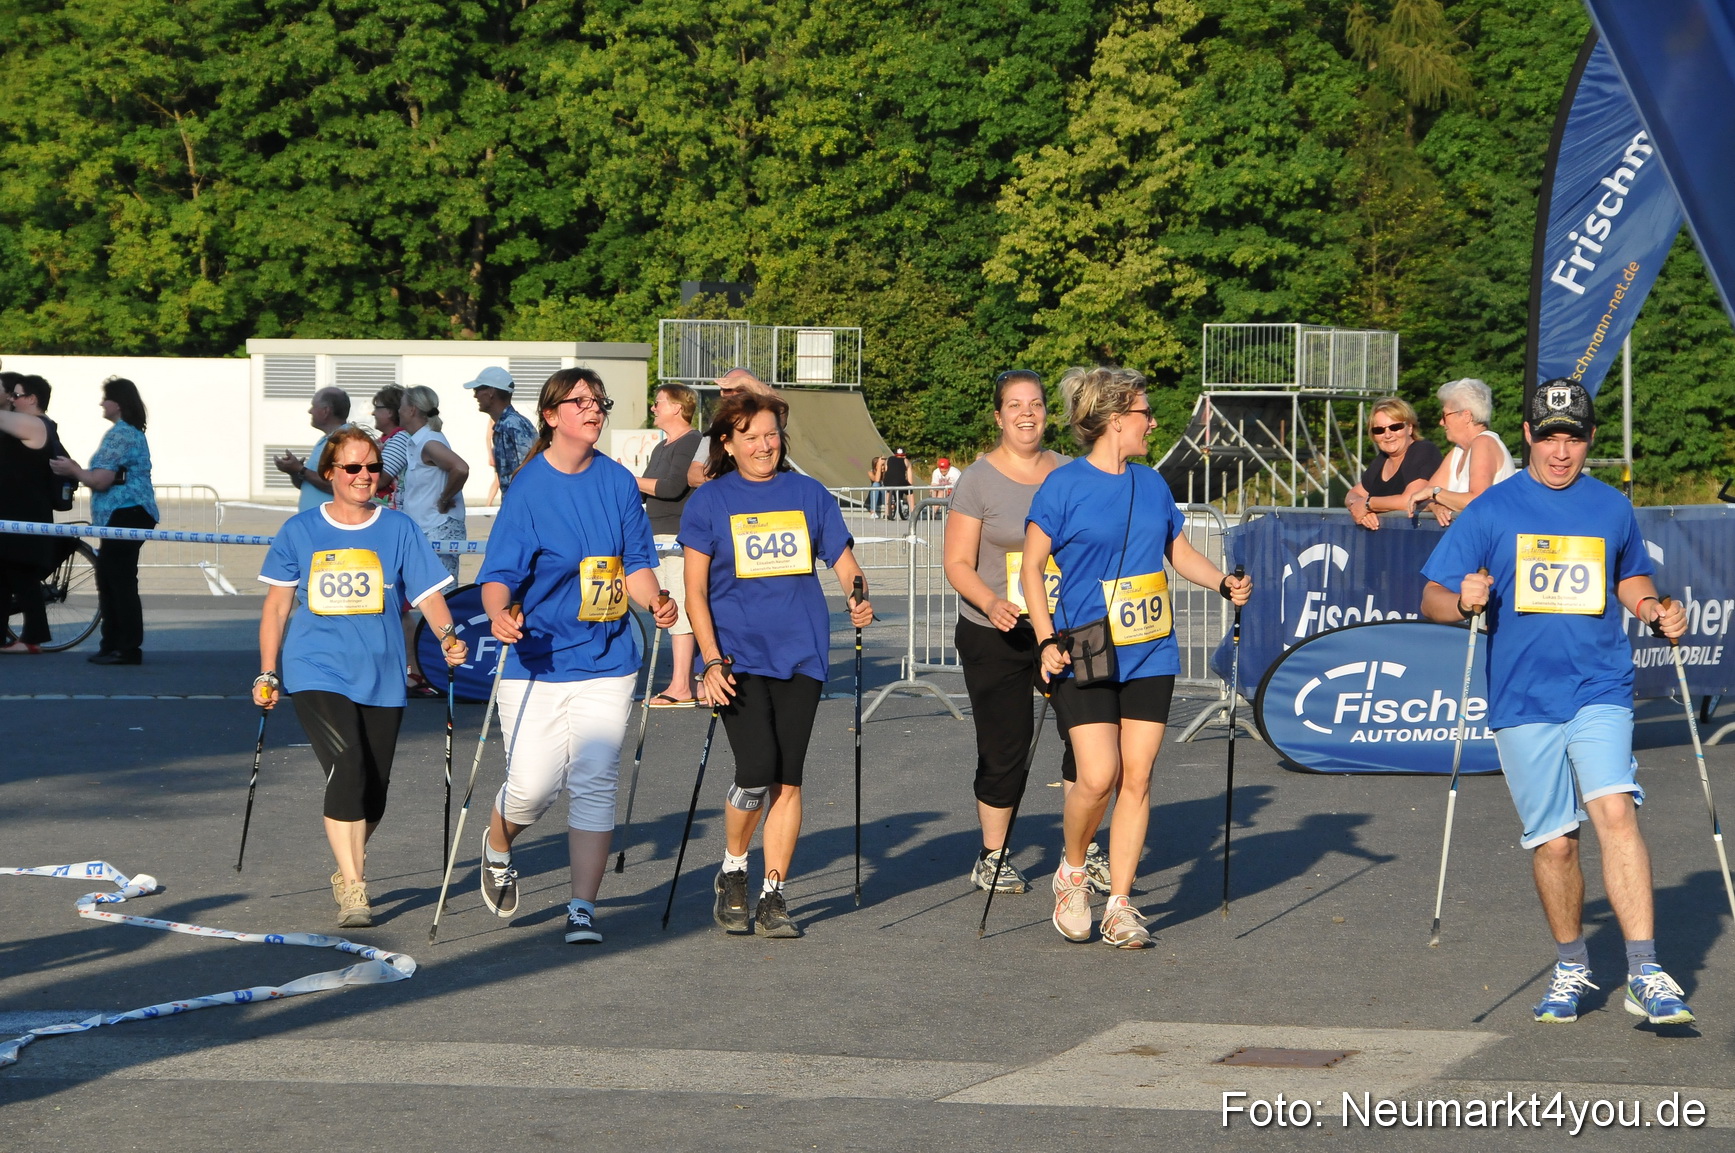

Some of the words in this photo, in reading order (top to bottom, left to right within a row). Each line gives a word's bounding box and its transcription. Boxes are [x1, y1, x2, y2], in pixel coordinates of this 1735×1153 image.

[1566, 260, 1640, 382] schmann-net.de
[746, 532, 798, 560] 648
[319, 572, 371, 598] 683
[592, 579, 624, 606] 718
[1529, 562, 1590, 594] 679
[1120, 595, 1163, 628] 619
